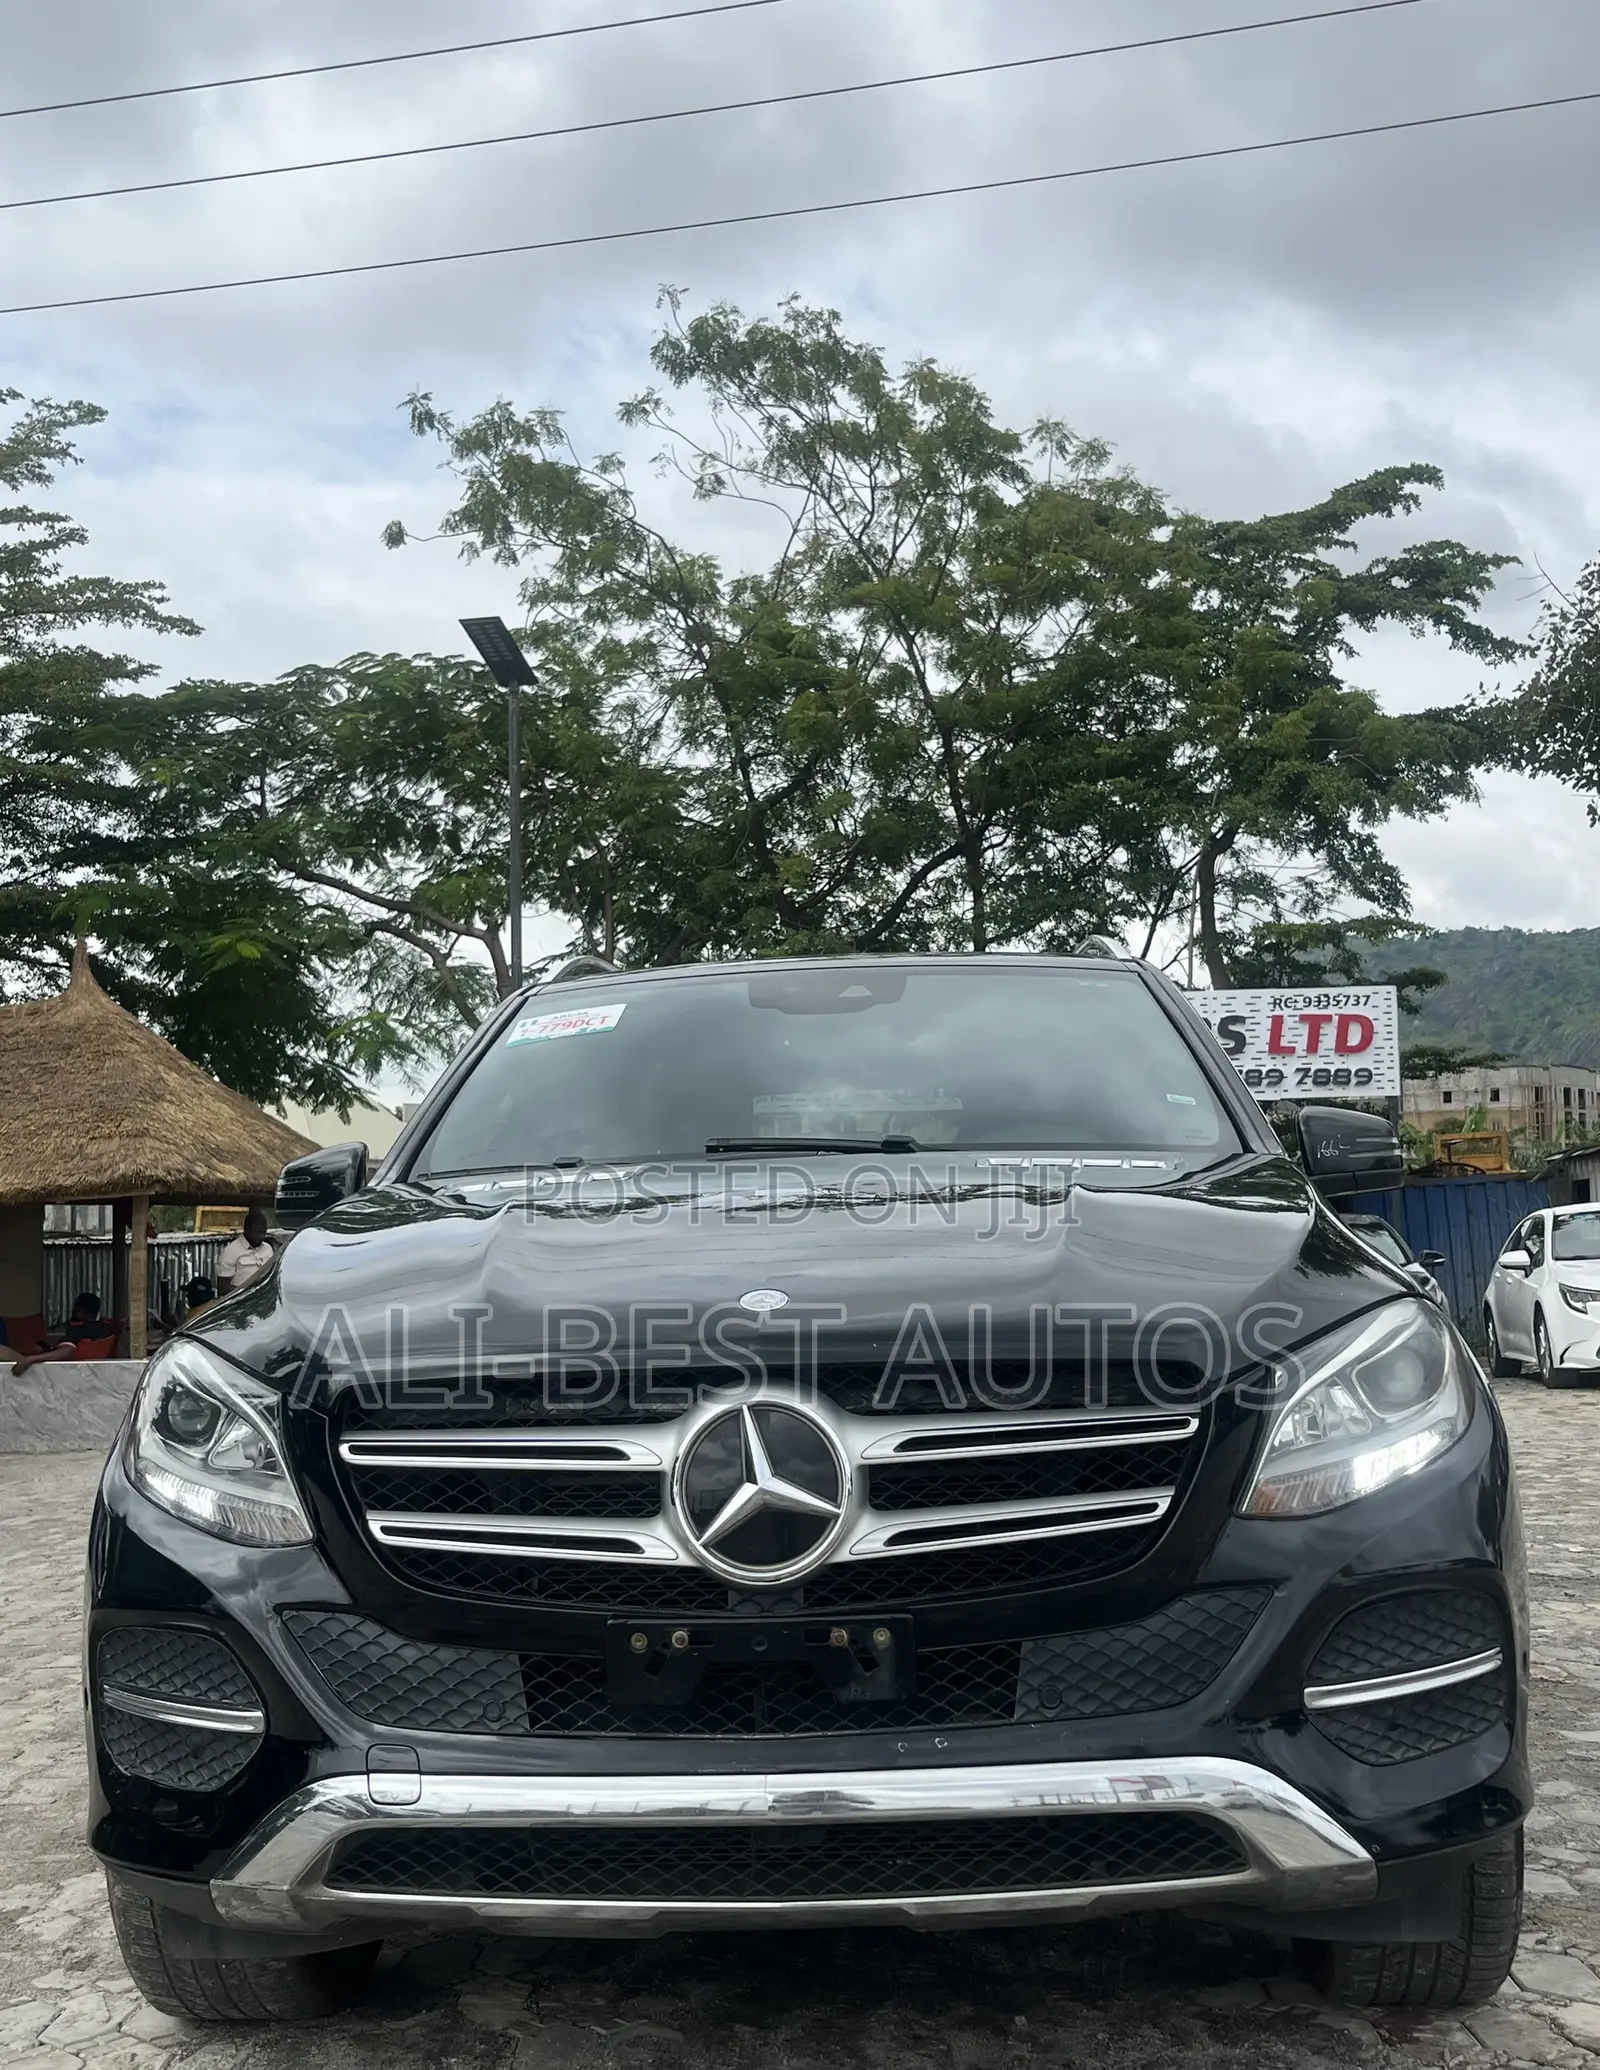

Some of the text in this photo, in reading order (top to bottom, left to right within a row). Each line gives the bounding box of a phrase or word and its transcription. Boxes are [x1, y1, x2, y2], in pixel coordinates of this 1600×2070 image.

[1303, 994, 1371, 1009] 9335737
[1267, 1013, 1375, 1055] LTD
[1236, 1066, 1374, 1087] 89 7889
